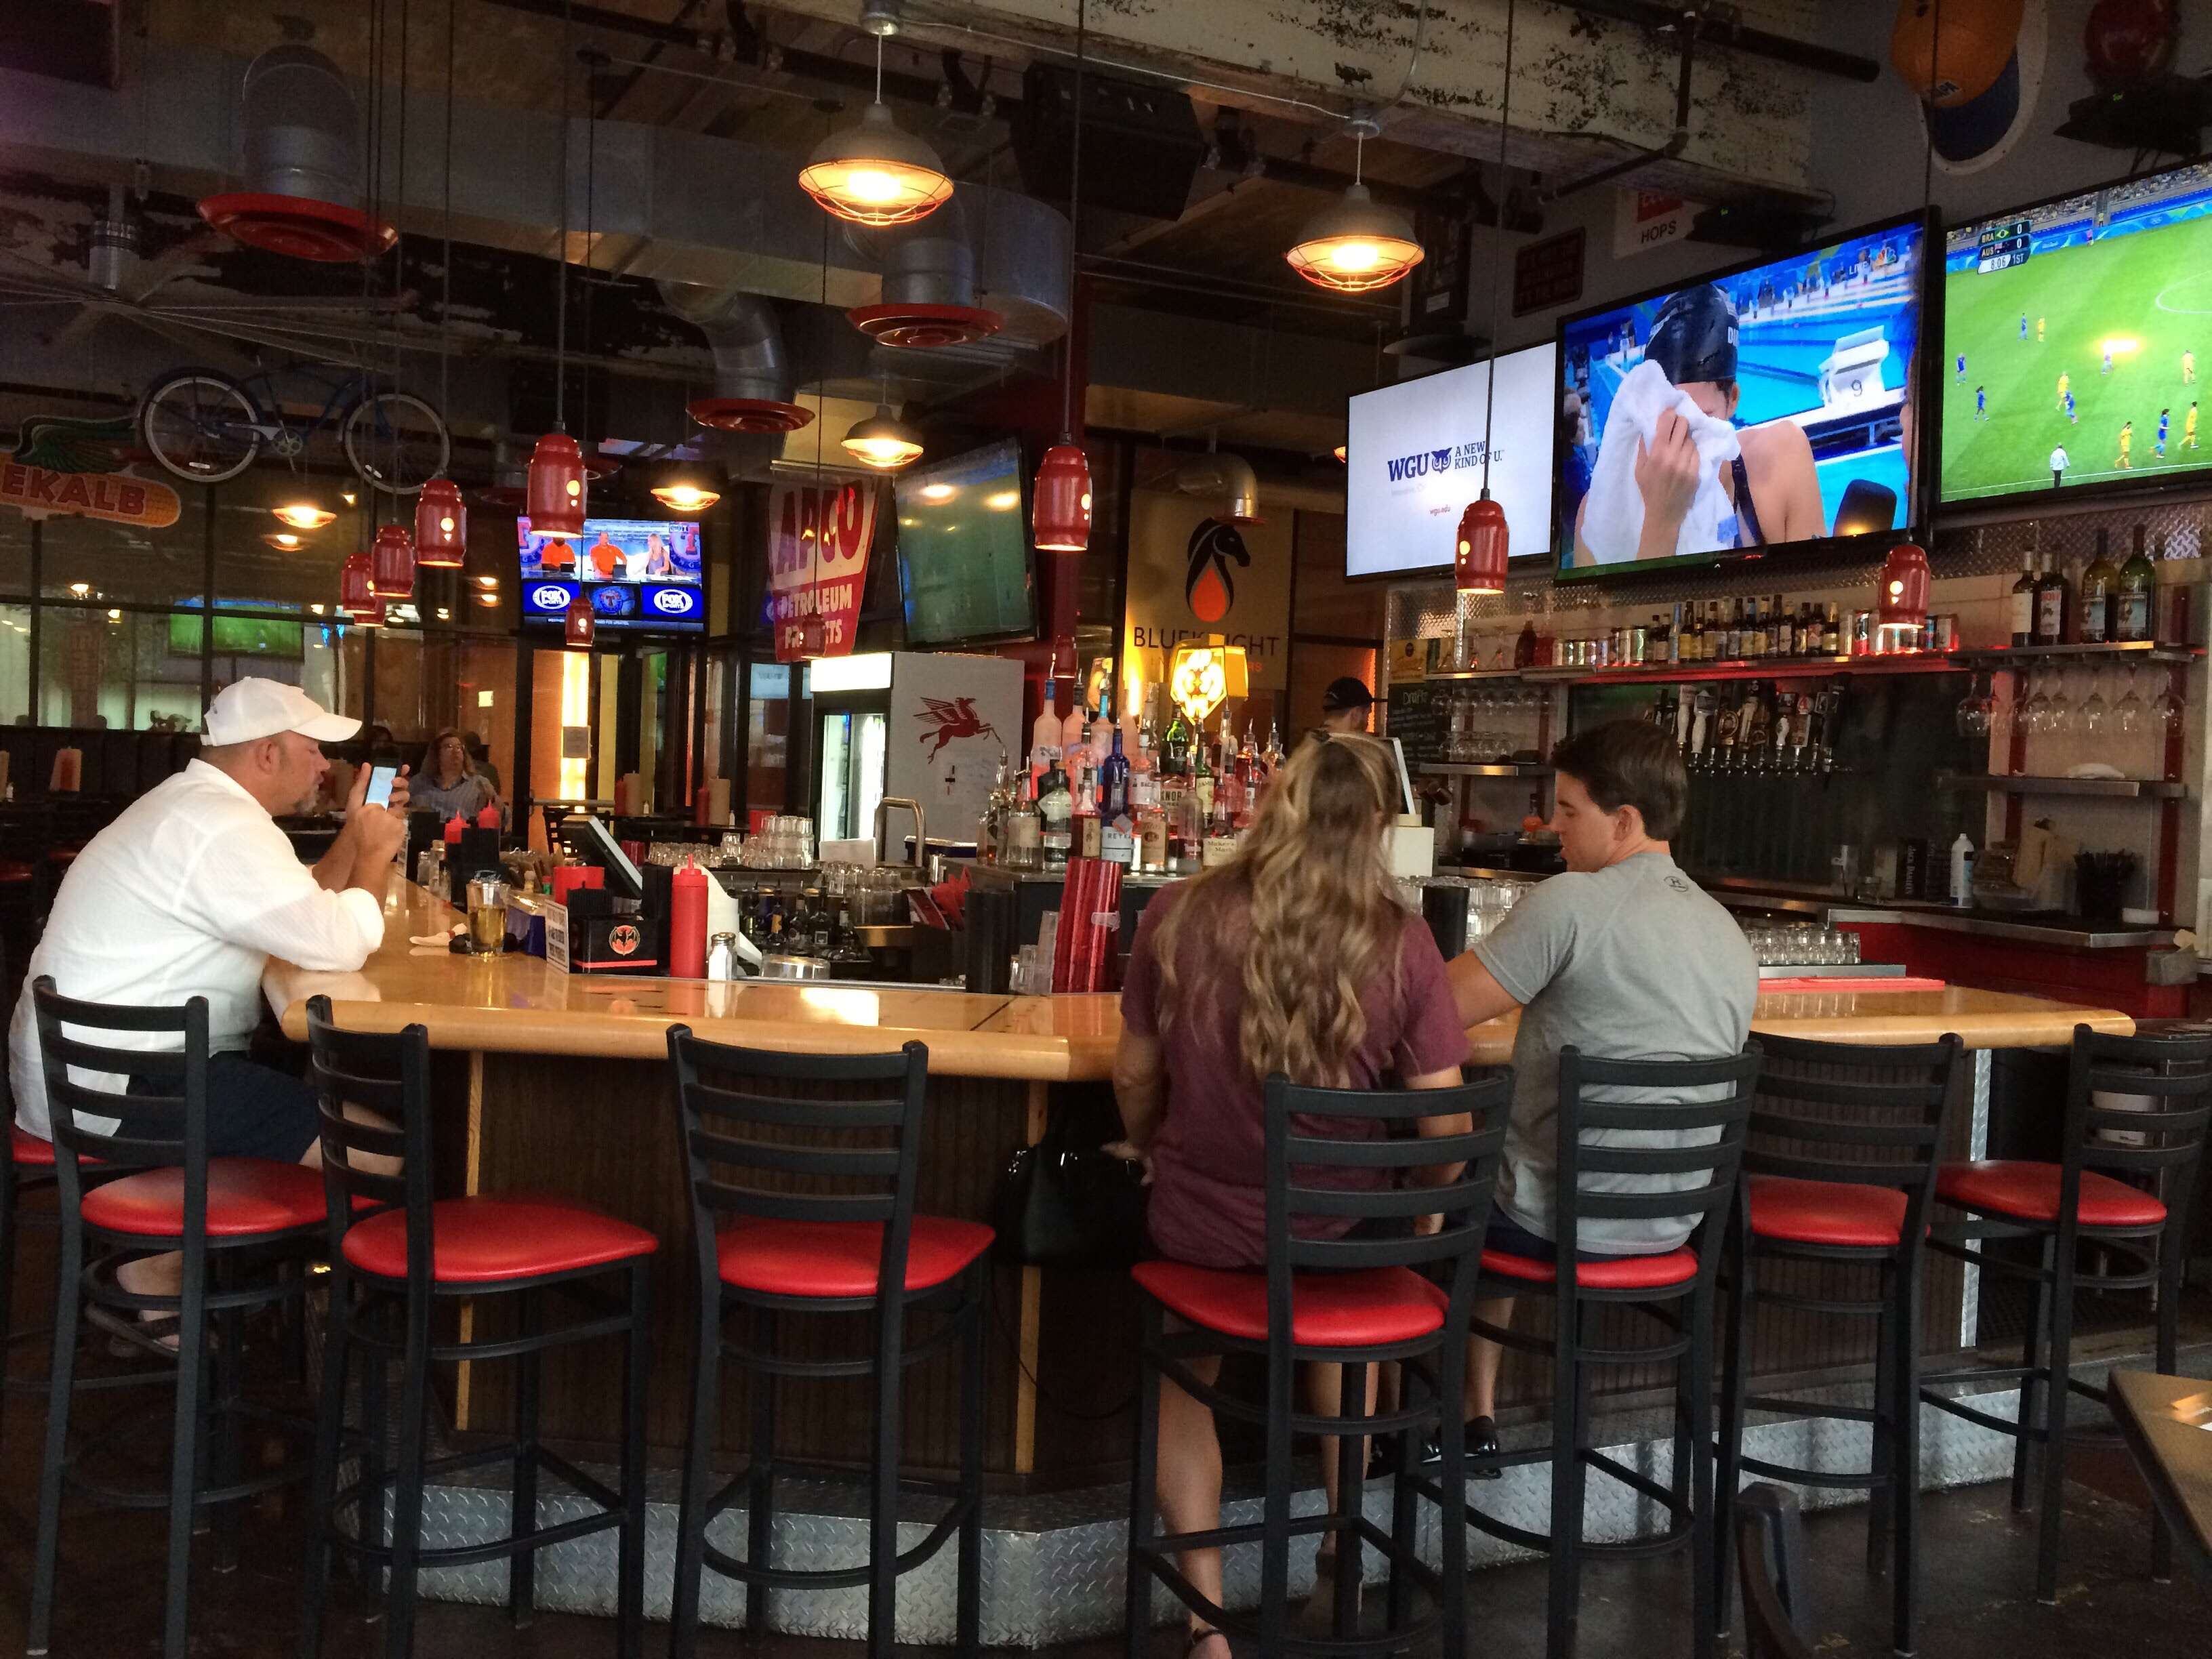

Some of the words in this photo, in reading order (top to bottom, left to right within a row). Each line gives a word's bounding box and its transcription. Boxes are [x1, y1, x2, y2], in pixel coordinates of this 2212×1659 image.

[1641, 220, 1677, 244] HOPS
[1982, 233, 1994, 243] BRA
[2017, 224, 2022, 234] 0
[1982, 247, 1994, 258] AUS
[2017, 238, 2022, 249] 0
[2012, 253, 2024, 264] 1ST
[1387, 453, 1429, 482] WGU
[1454, 446, 1462, 457] A
[1464, 441, 1486, 456] NEW
[1454, 455, 1478, 470] KIND
[775, 480, 864, 575] APCO
[541, 590, 562, 600] FOX
[661, 594, 684, 604] FOX
[780, 583, 853, 619] PETROLEUM
